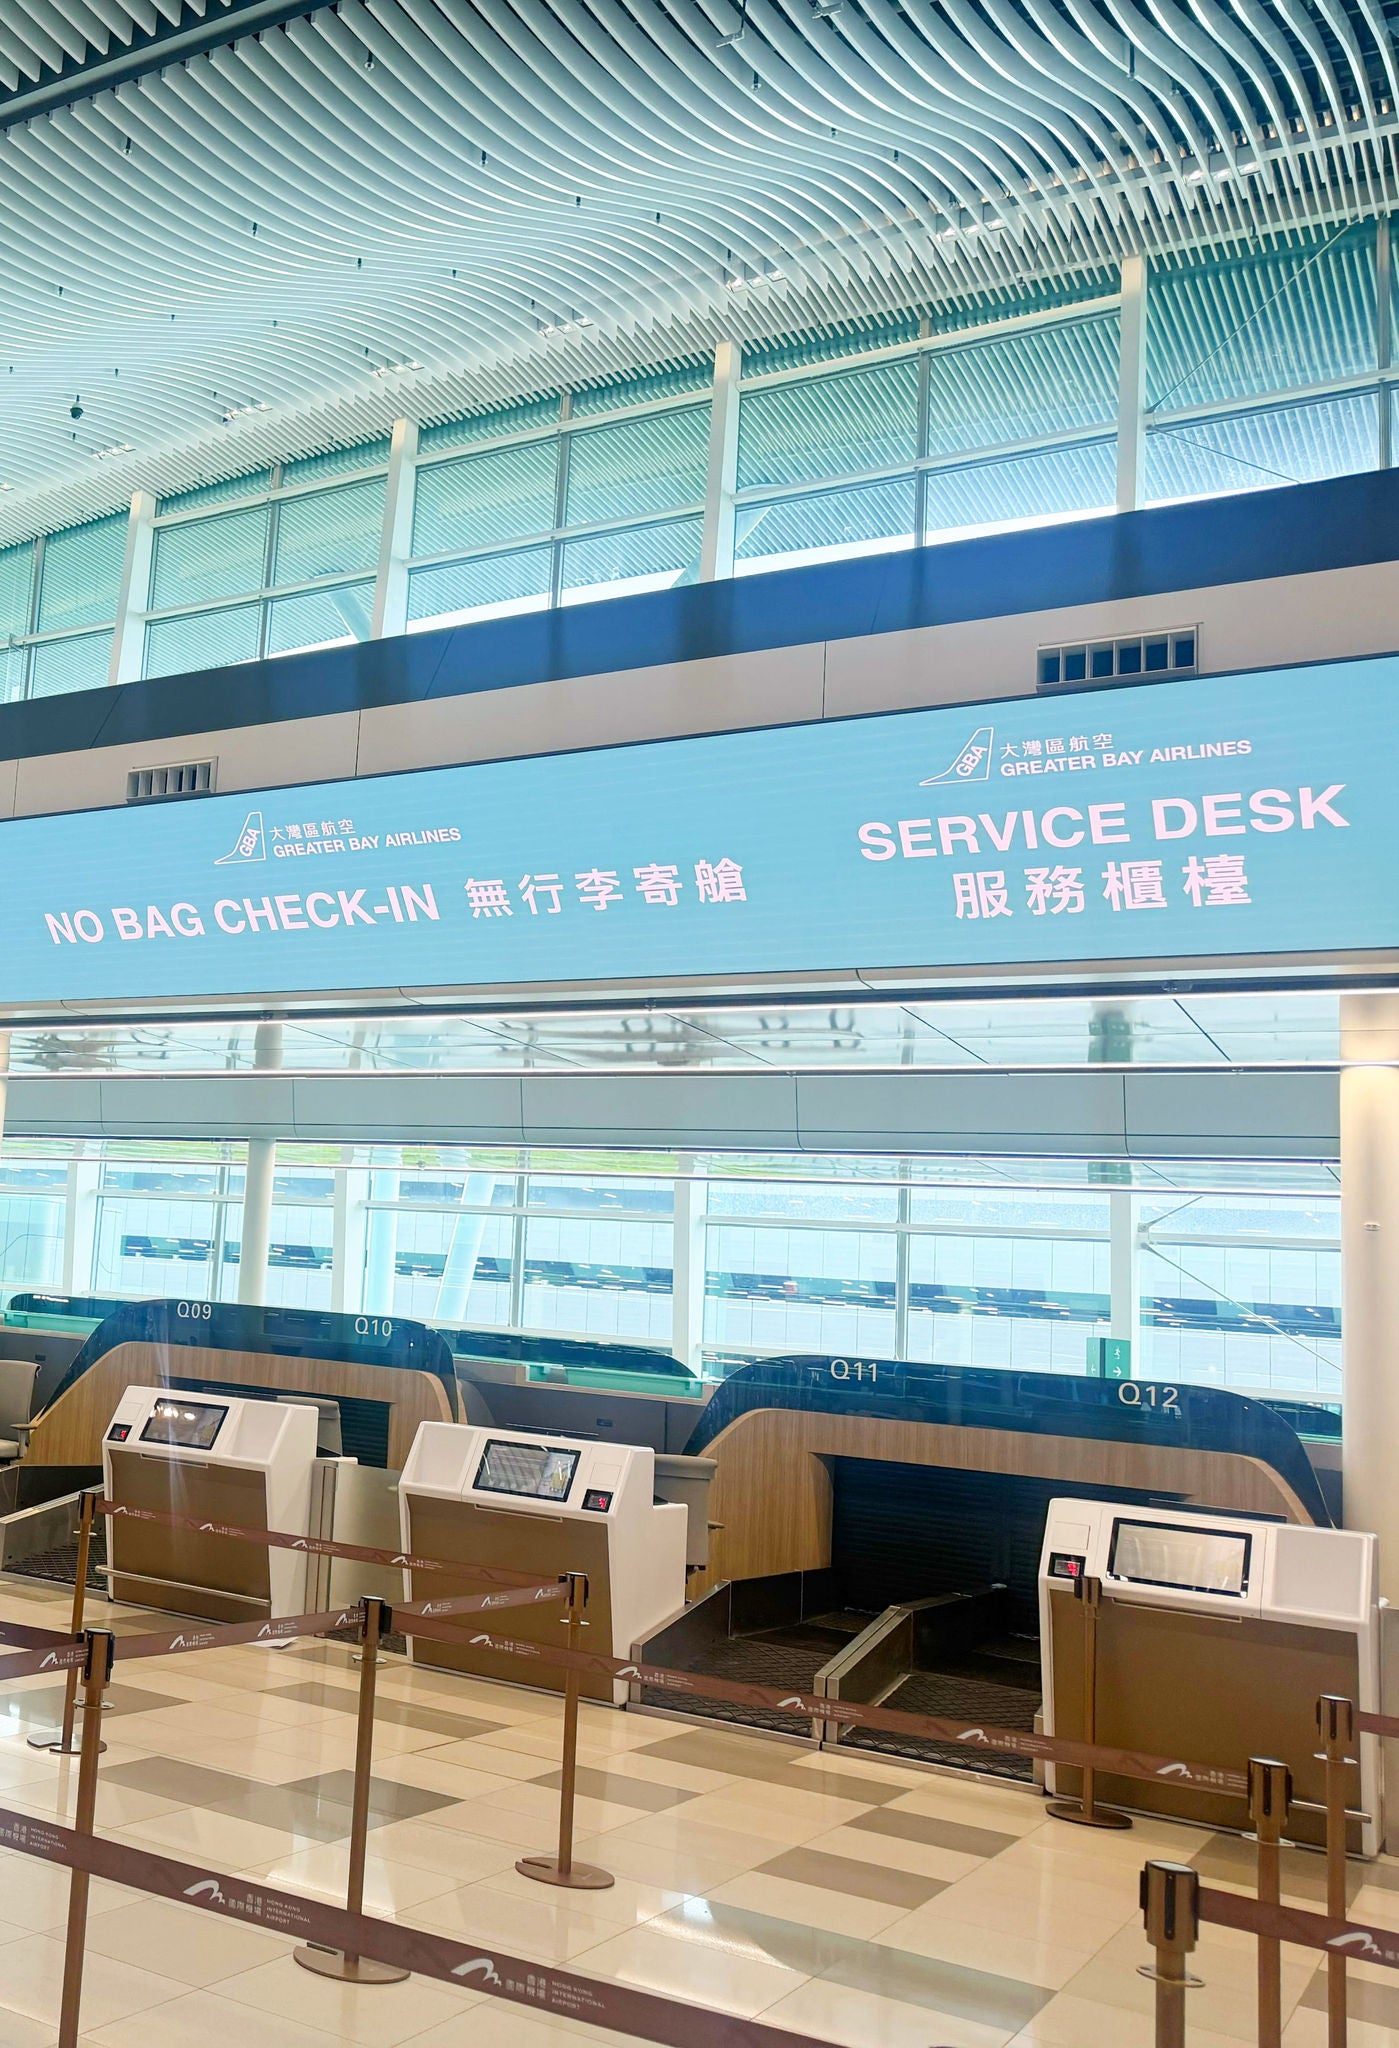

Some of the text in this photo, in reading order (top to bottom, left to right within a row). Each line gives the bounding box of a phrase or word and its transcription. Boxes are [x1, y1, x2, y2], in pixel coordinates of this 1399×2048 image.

[955, 744, 988, 777] GBA
[1000, 733, 1114, 759] 大灣區航空
[1000, 739, 1252, 777] GREATER BAY AIRLINES
[269, 819, 356, 842] 大灣區航空
[857, 784, 1351, 861] SERVICE DESK
[239, 828, 260, 857] GBA
[273, 827, 462, 859] GREATER BAY AIRLINES
[464, 857, 748, 919] 無行李寄艙
[953, 854, 1252, 920] 服務櫃檯
[44, 883, 440, 945] NO BAG CHECK-IN
[177, 1301, 212, 1320] Q09
[354, 1317, 392, 1337] Q10
[830, 1359, 877, 1382] Q11
[1118, 1382, 1178, 1409] Q12
